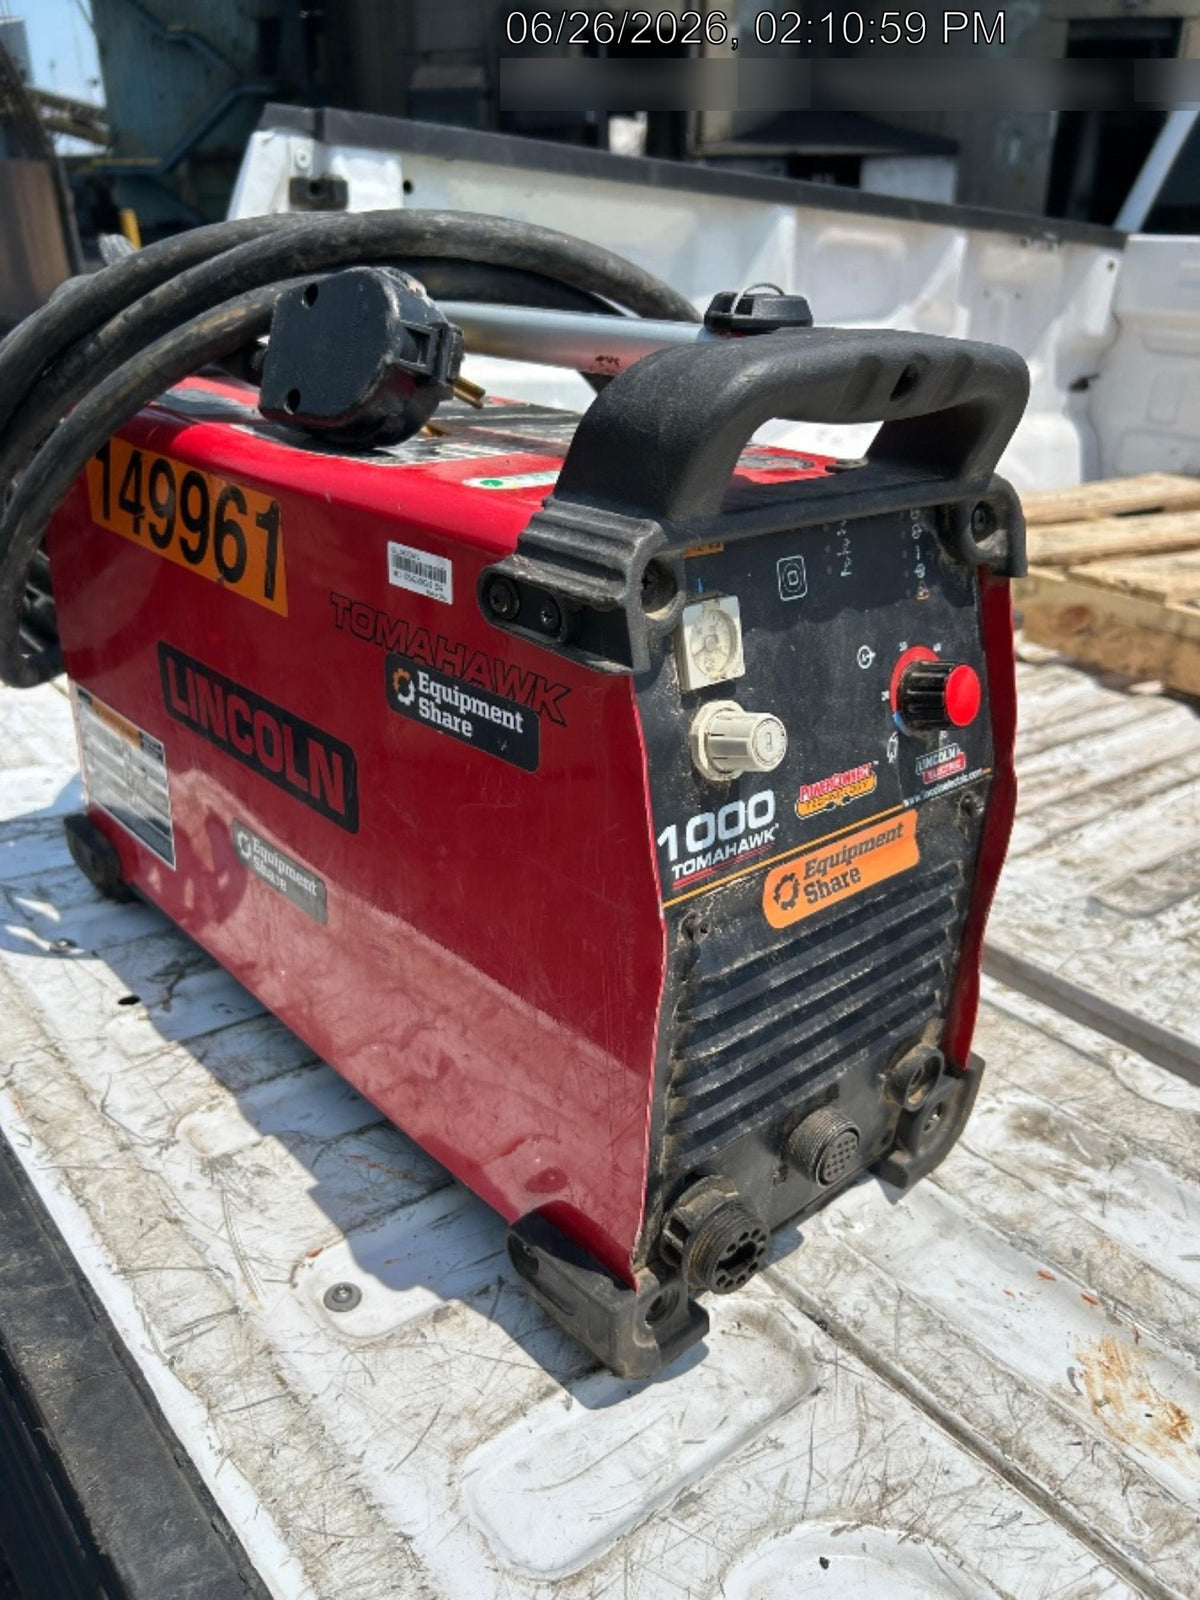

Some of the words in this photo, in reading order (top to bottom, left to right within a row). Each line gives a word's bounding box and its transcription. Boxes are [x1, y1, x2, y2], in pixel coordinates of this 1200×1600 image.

[94, 440, 280, 602] 149961
[330, 592, 573, 728] TOMAHAWK
[417, 670, 525, 734] Equipment
[418, 697, 474, 738] Share
[166, 656, 346, 817] LINCOLN
[657, 788, 777, 862] 1000
[671, 828, 776, 880] TOMAHAWK
[803, 822, 905, 881] Equipment
[252, 836, 318, 897] Equipment
[252, 856, 288, 893] Share
[803, 864, 862, 905] Share
